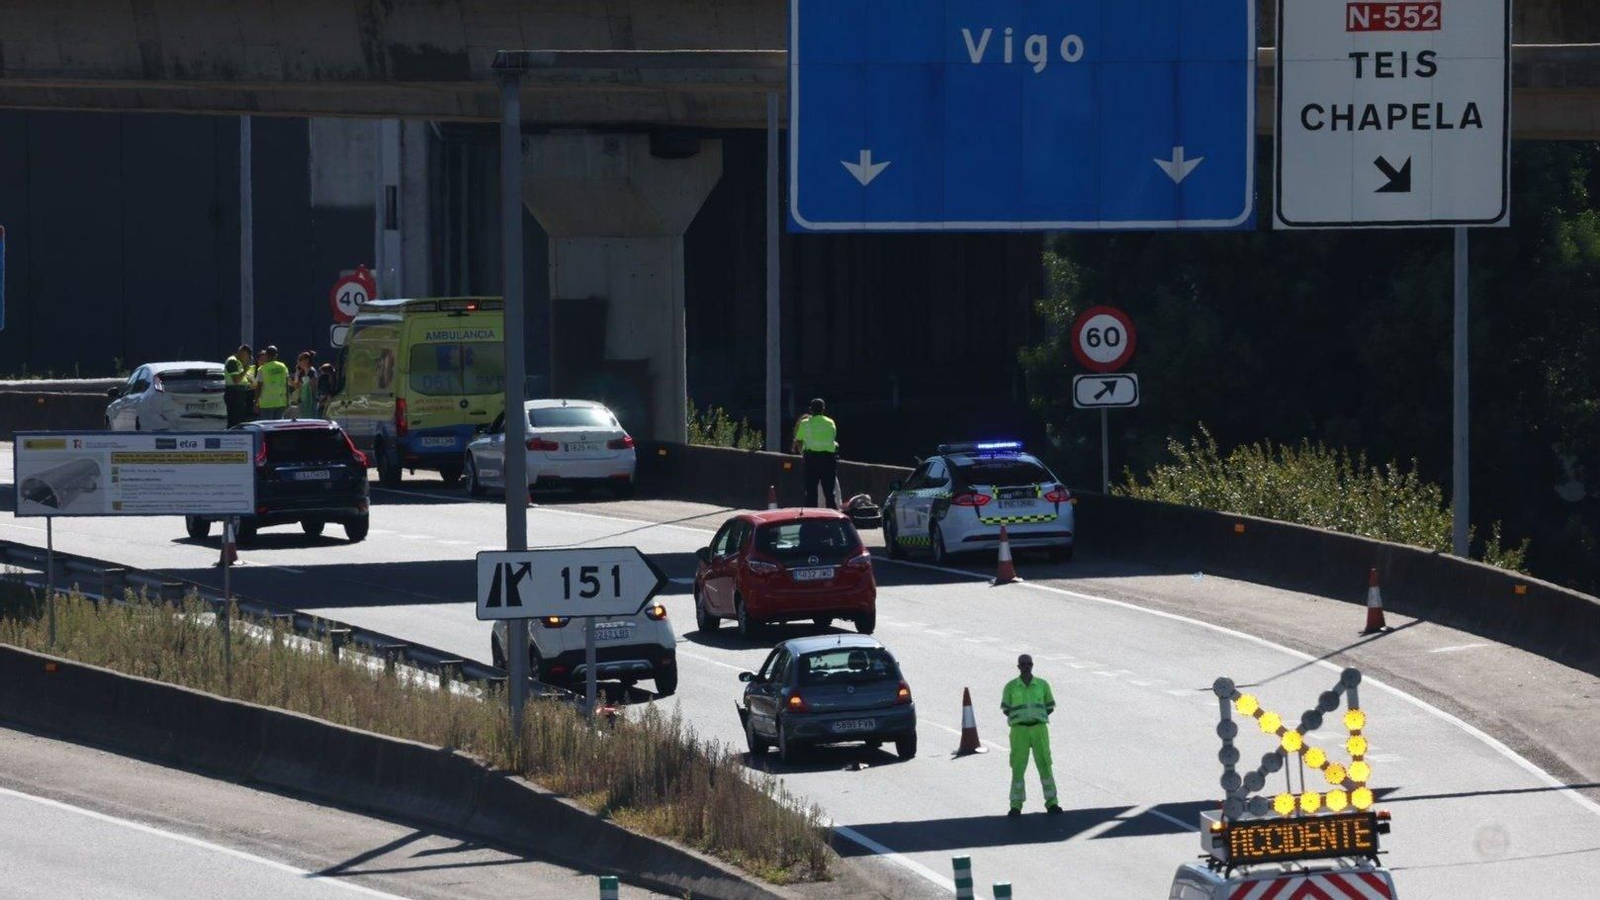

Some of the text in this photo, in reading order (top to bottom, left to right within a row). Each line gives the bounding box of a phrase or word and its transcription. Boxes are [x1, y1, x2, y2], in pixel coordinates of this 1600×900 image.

[1349, 4, 1437, 29] N-552
[961, 26, 1084, 74] Vigo
[1348, 50, 1438, 79] TEIS
[1300, 101, 1483, 132] CHAPELA
[339, 291, 365, 307] 40
[425, 330, 496, 340] AMBULANCIA
[1086, 326, 1121, 348] 60
[179, 440, 199, 449] etra
[562, 565, 621, 600] 151
[1230, 819, 1372, 857] ACCIDENTE
